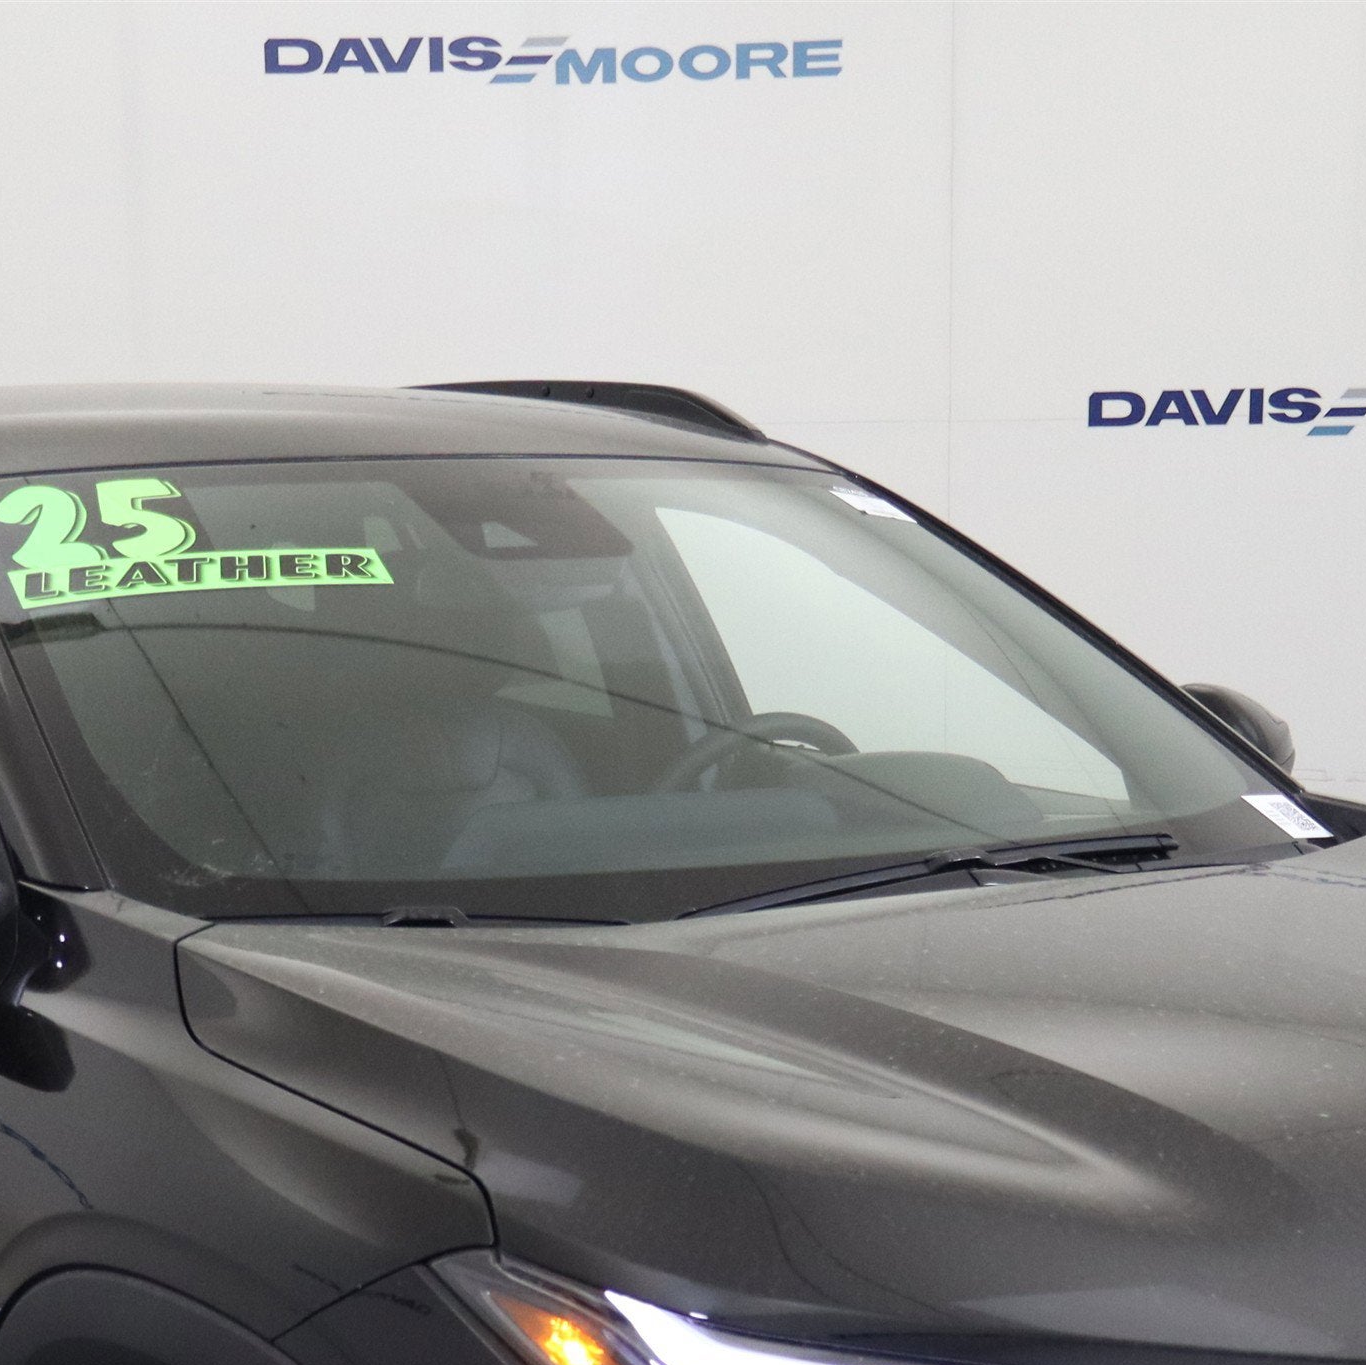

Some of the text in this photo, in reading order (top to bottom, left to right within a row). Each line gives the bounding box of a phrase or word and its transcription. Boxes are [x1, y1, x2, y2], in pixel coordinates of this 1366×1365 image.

[264, 36, 843, 85] DAVIS MOORE
[1087, 387, 1323, 427] DAVIS
[24, 553, 374, 601] LEATHER
